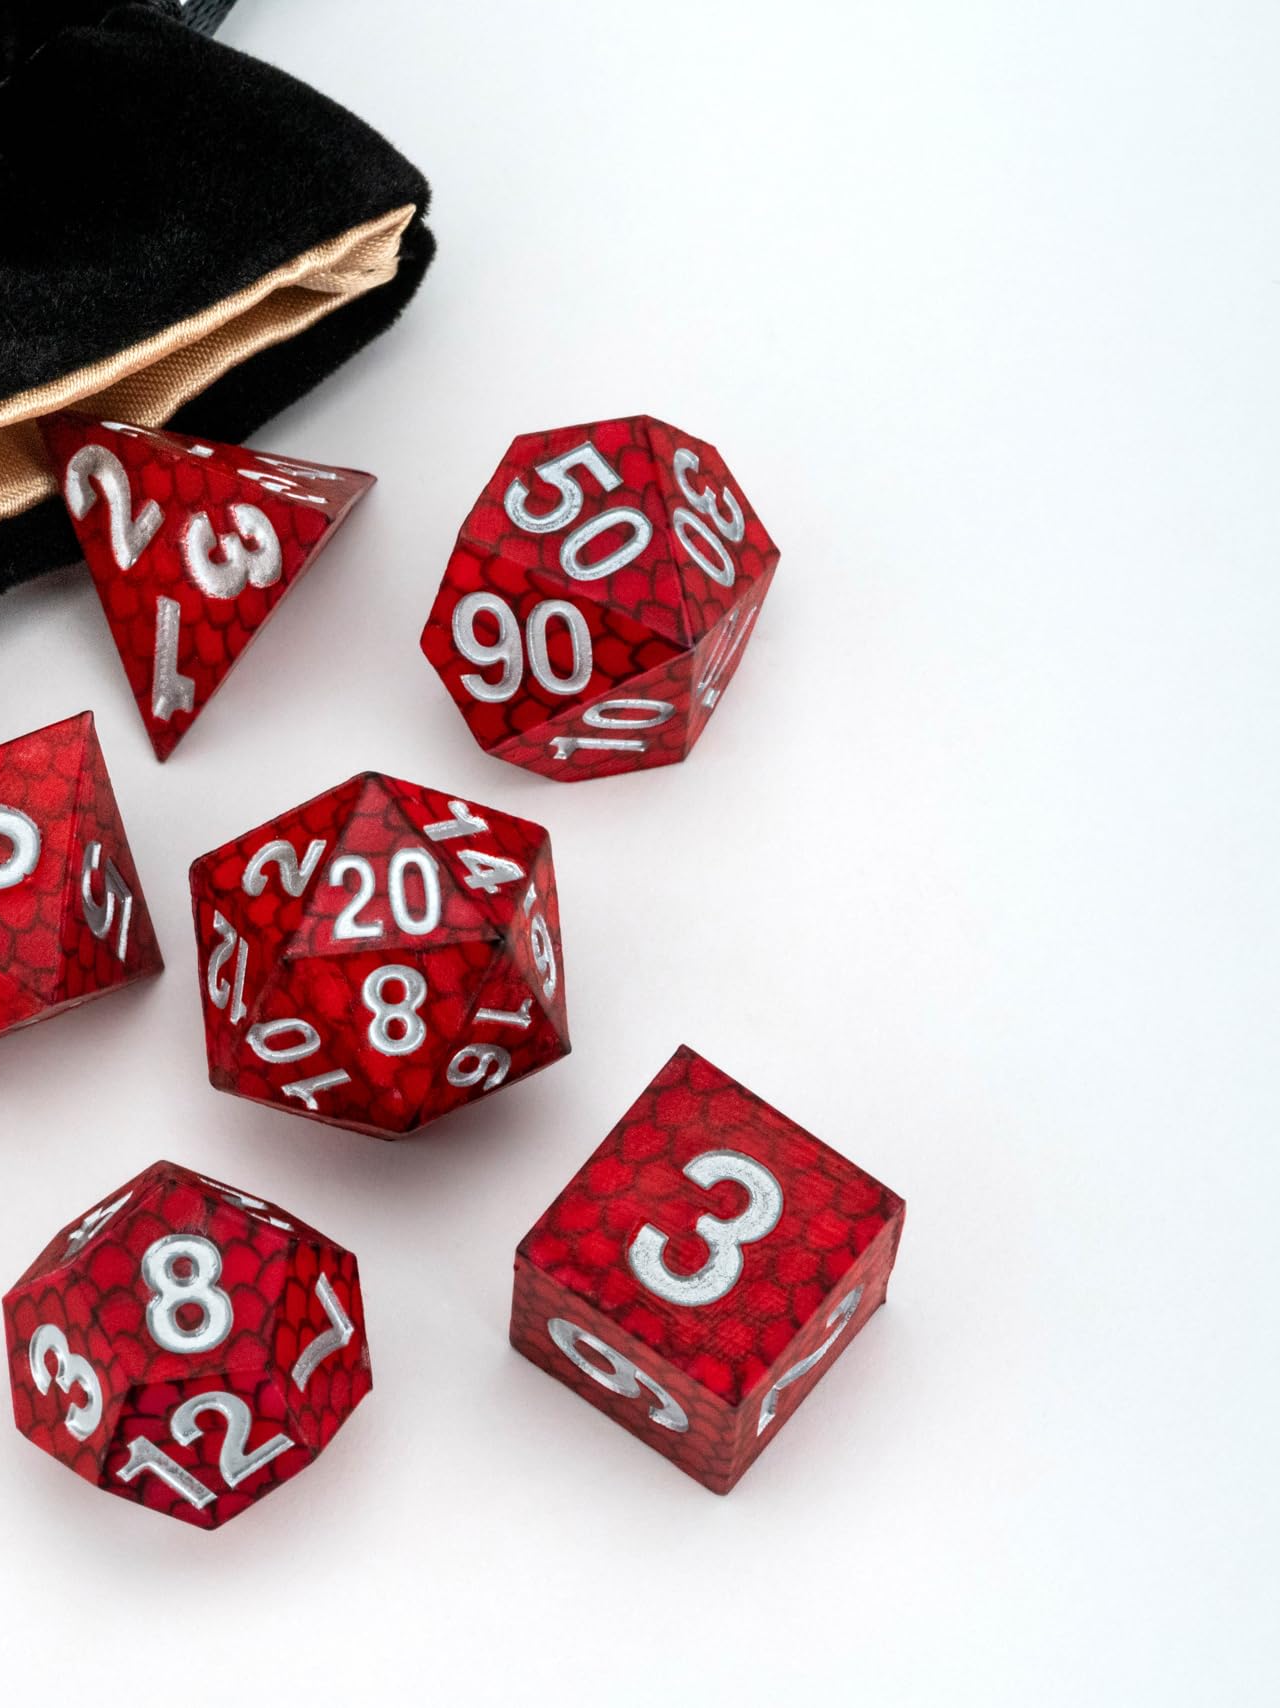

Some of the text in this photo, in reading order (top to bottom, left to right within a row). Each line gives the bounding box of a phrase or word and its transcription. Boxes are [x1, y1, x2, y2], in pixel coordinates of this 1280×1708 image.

[66, 444, 165, 571] 2
[184, 503, 283, 600] 3
[504, 441, 653, 581] 50
[673, 447, 745, 587] 30
[153, 596, 196, 721] 1
[452, 592, 593, 703] 90
[550, 699, 676, 760] 10
[81, 841, 132, 963] 5
[242, 839, 327, 897] 2
[329, 847, 441, 940] 20
[423, 800, 525, 894] 14
[207, 909, 248, 1025] 12
[362, 964, 427, 1056] 8
[245, 1017, 352, 1110] 10
[629, 1149, 783, 1307] 3
[141, 1234, 234, 1354] 8
[291, 1272, 354, 1393] 7
[29, 1323, 103, 1441] 3
[757, 1283, 864, 1437] 2
[116, 1391, 295, 1510] 12
